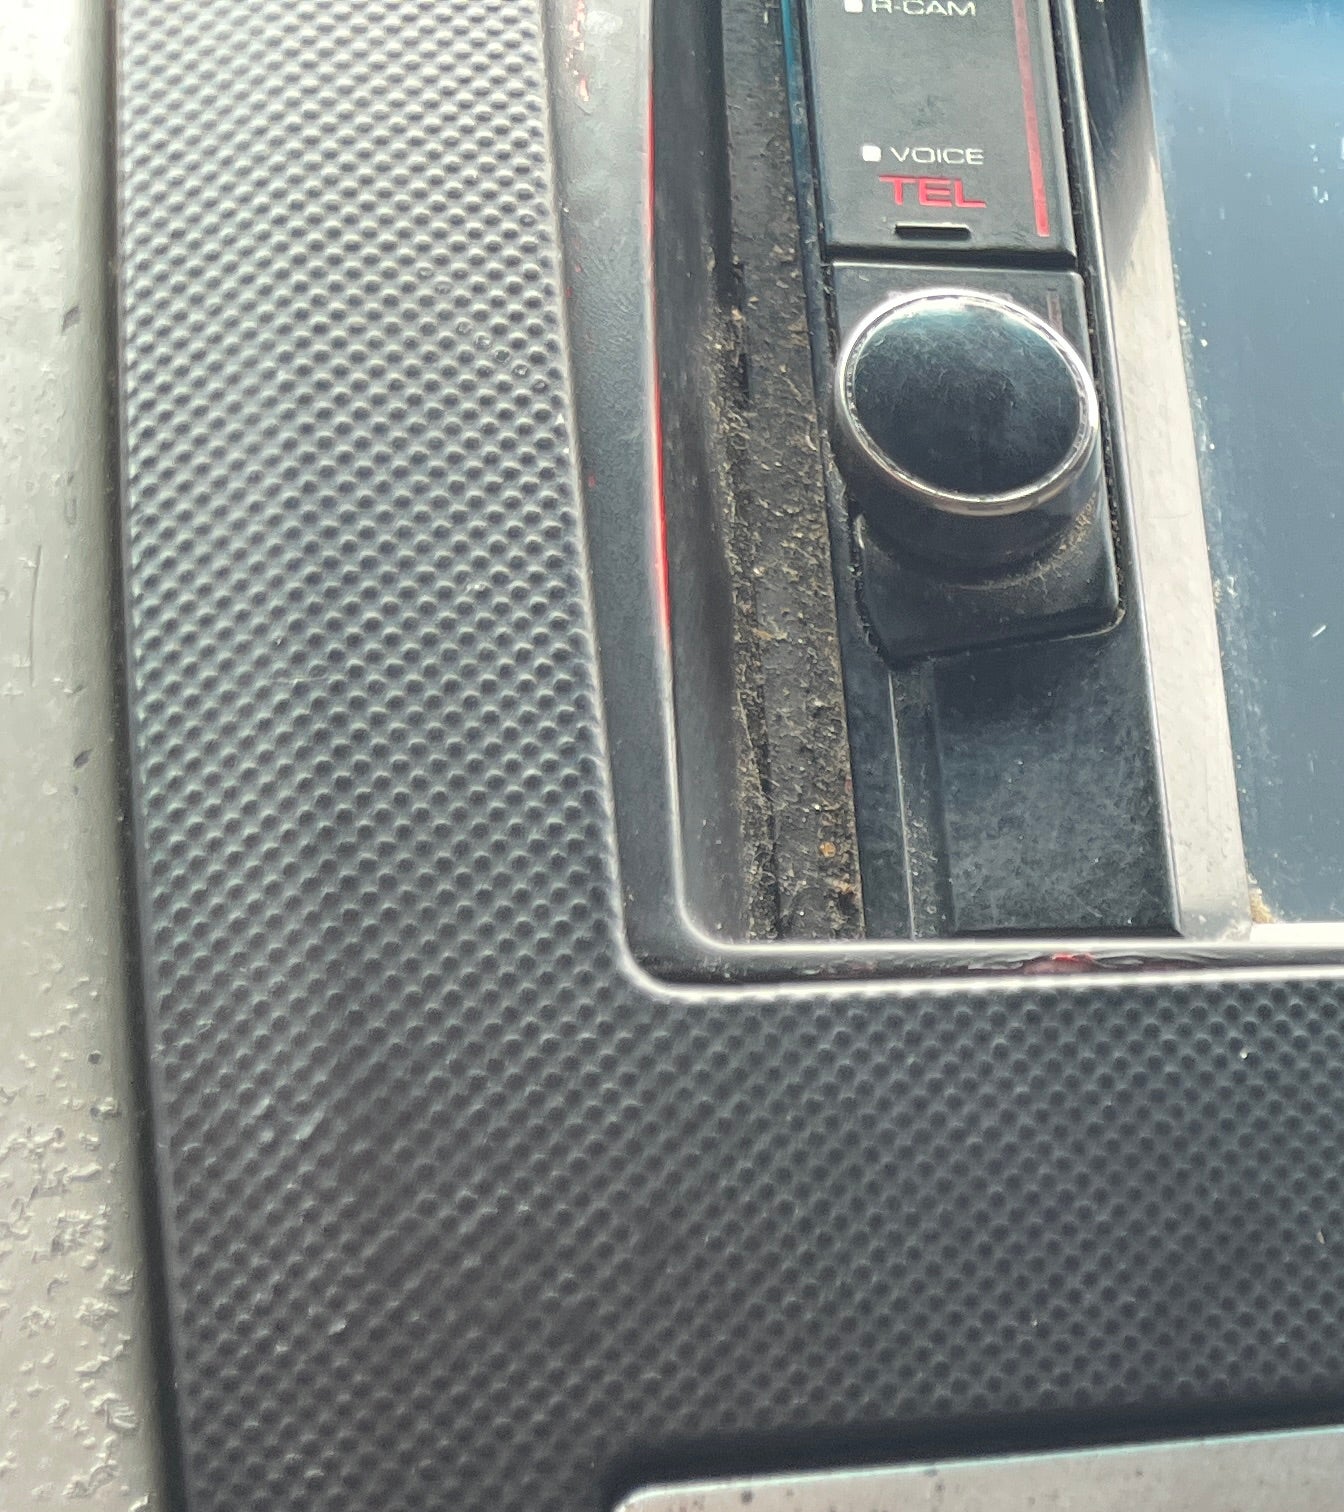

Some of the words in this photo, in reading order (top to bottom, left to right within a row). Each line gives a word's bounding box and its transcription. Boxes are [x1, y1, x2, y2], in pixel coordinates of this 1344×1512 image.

[871, 0, 977, 17] R-CAM
[889, 146, 985, 166] VOICE
[879, 174, 987, 209] TEL
